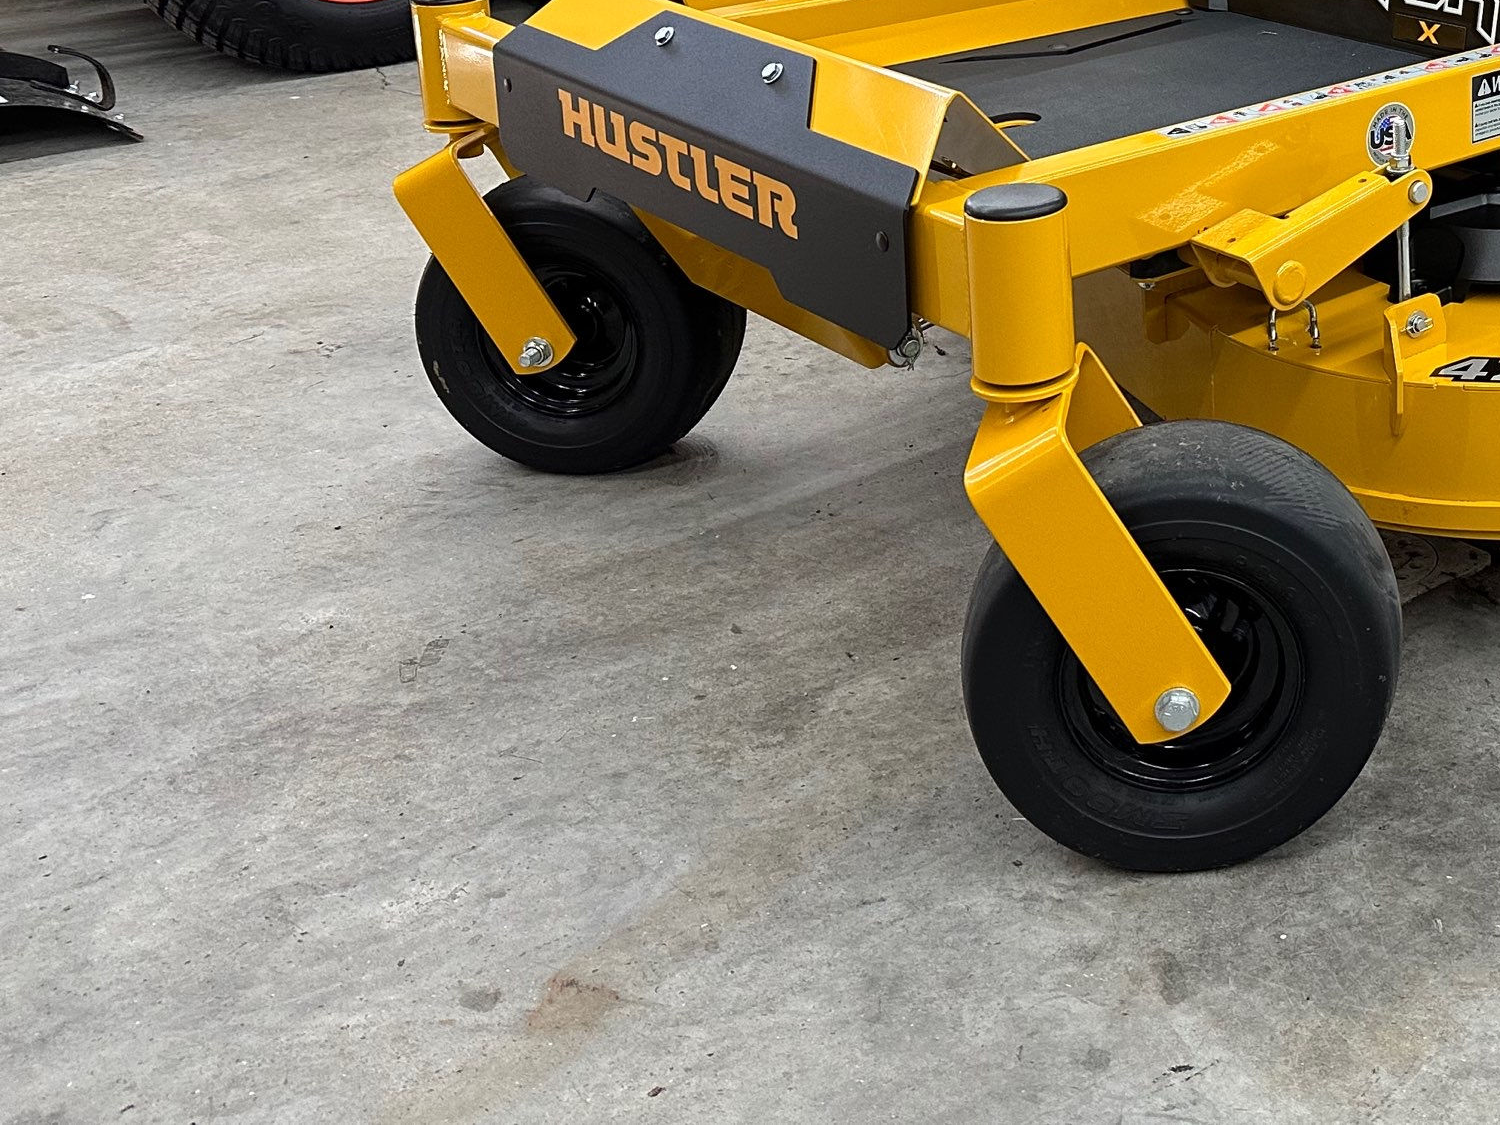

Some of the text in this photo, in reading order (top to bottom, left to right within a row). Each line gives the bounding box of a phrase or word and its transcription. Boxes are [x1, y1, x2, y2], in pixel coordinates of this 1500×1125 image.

[1417, 21, 1440, 45] X
[1372, 108, 1389, 128] MADE
[556, 87, 799, 240] HUSTLER
